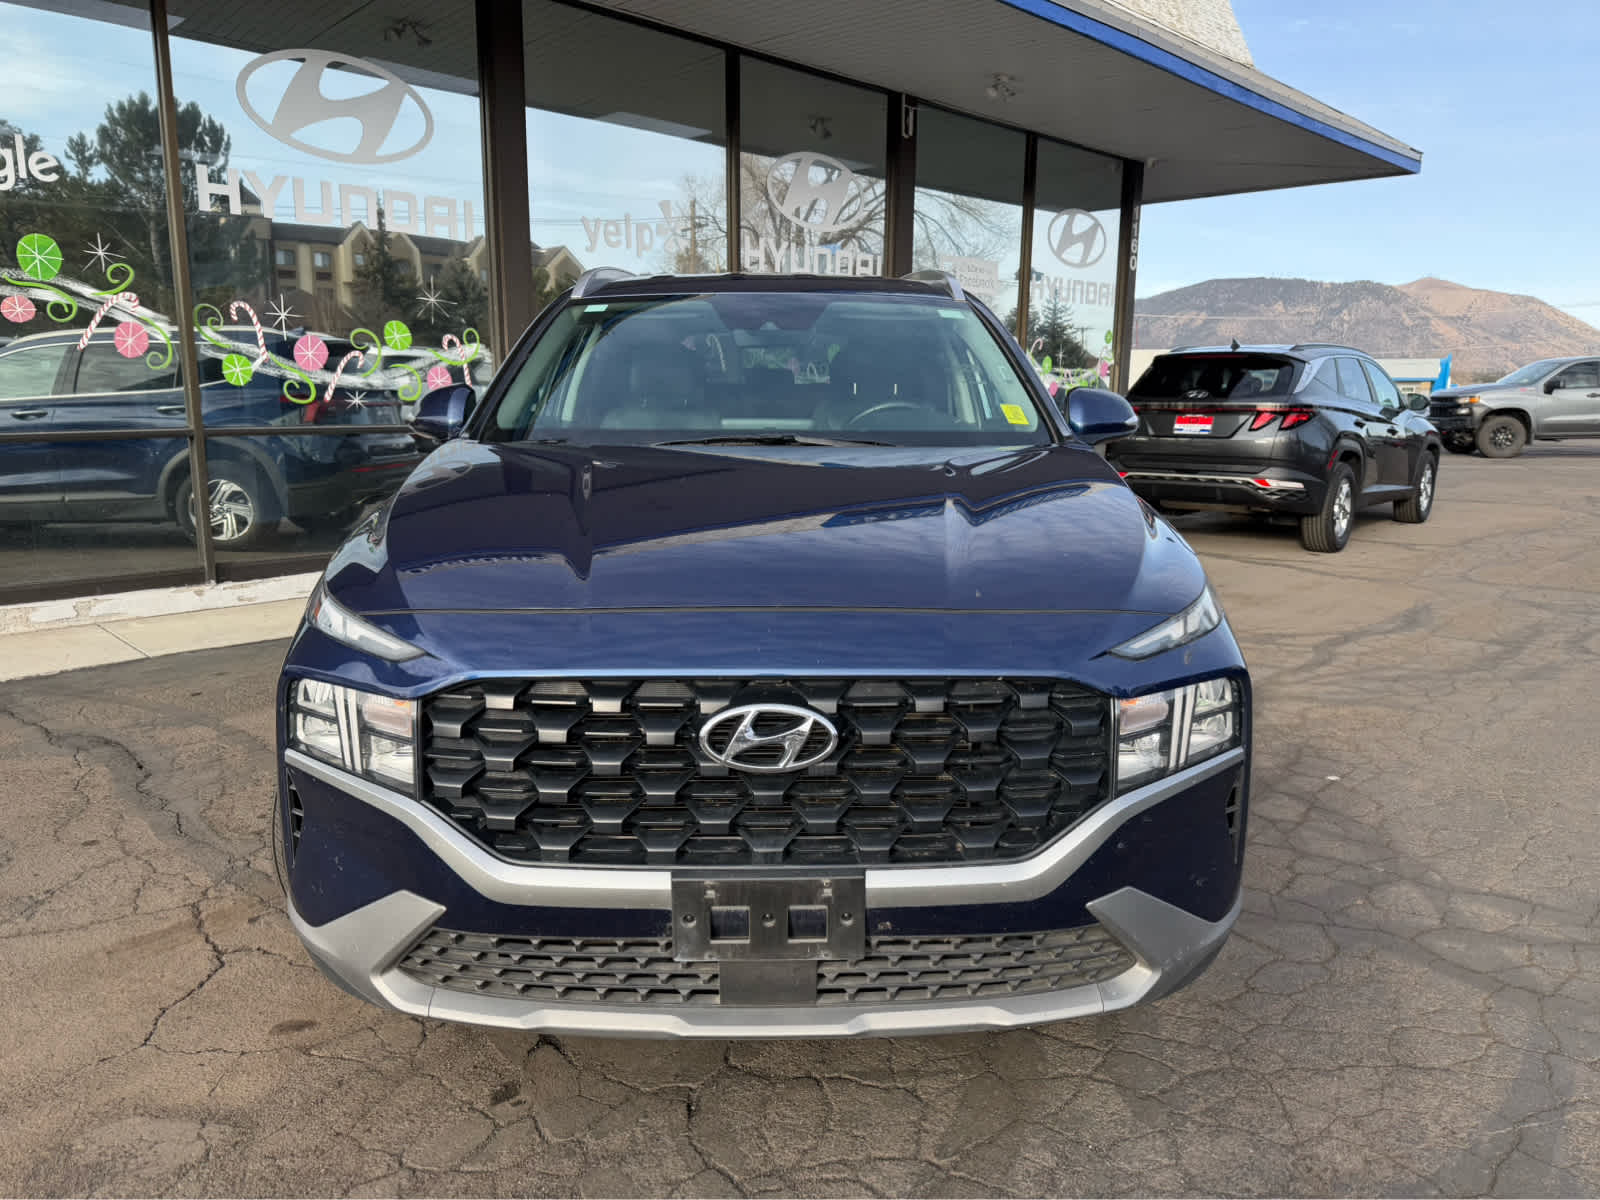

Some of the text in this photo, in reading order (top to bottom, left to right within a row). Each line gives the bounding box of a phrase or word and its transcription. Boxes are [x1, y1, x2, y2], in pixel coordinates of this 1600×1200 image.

[195, 163, 474, 241] HYUNDAI
[581, 212, 653, 258] yelp
[744, 234, 882, 276] HYUNDAI
[1031, 275, 1115, 306] HYUNDAI
